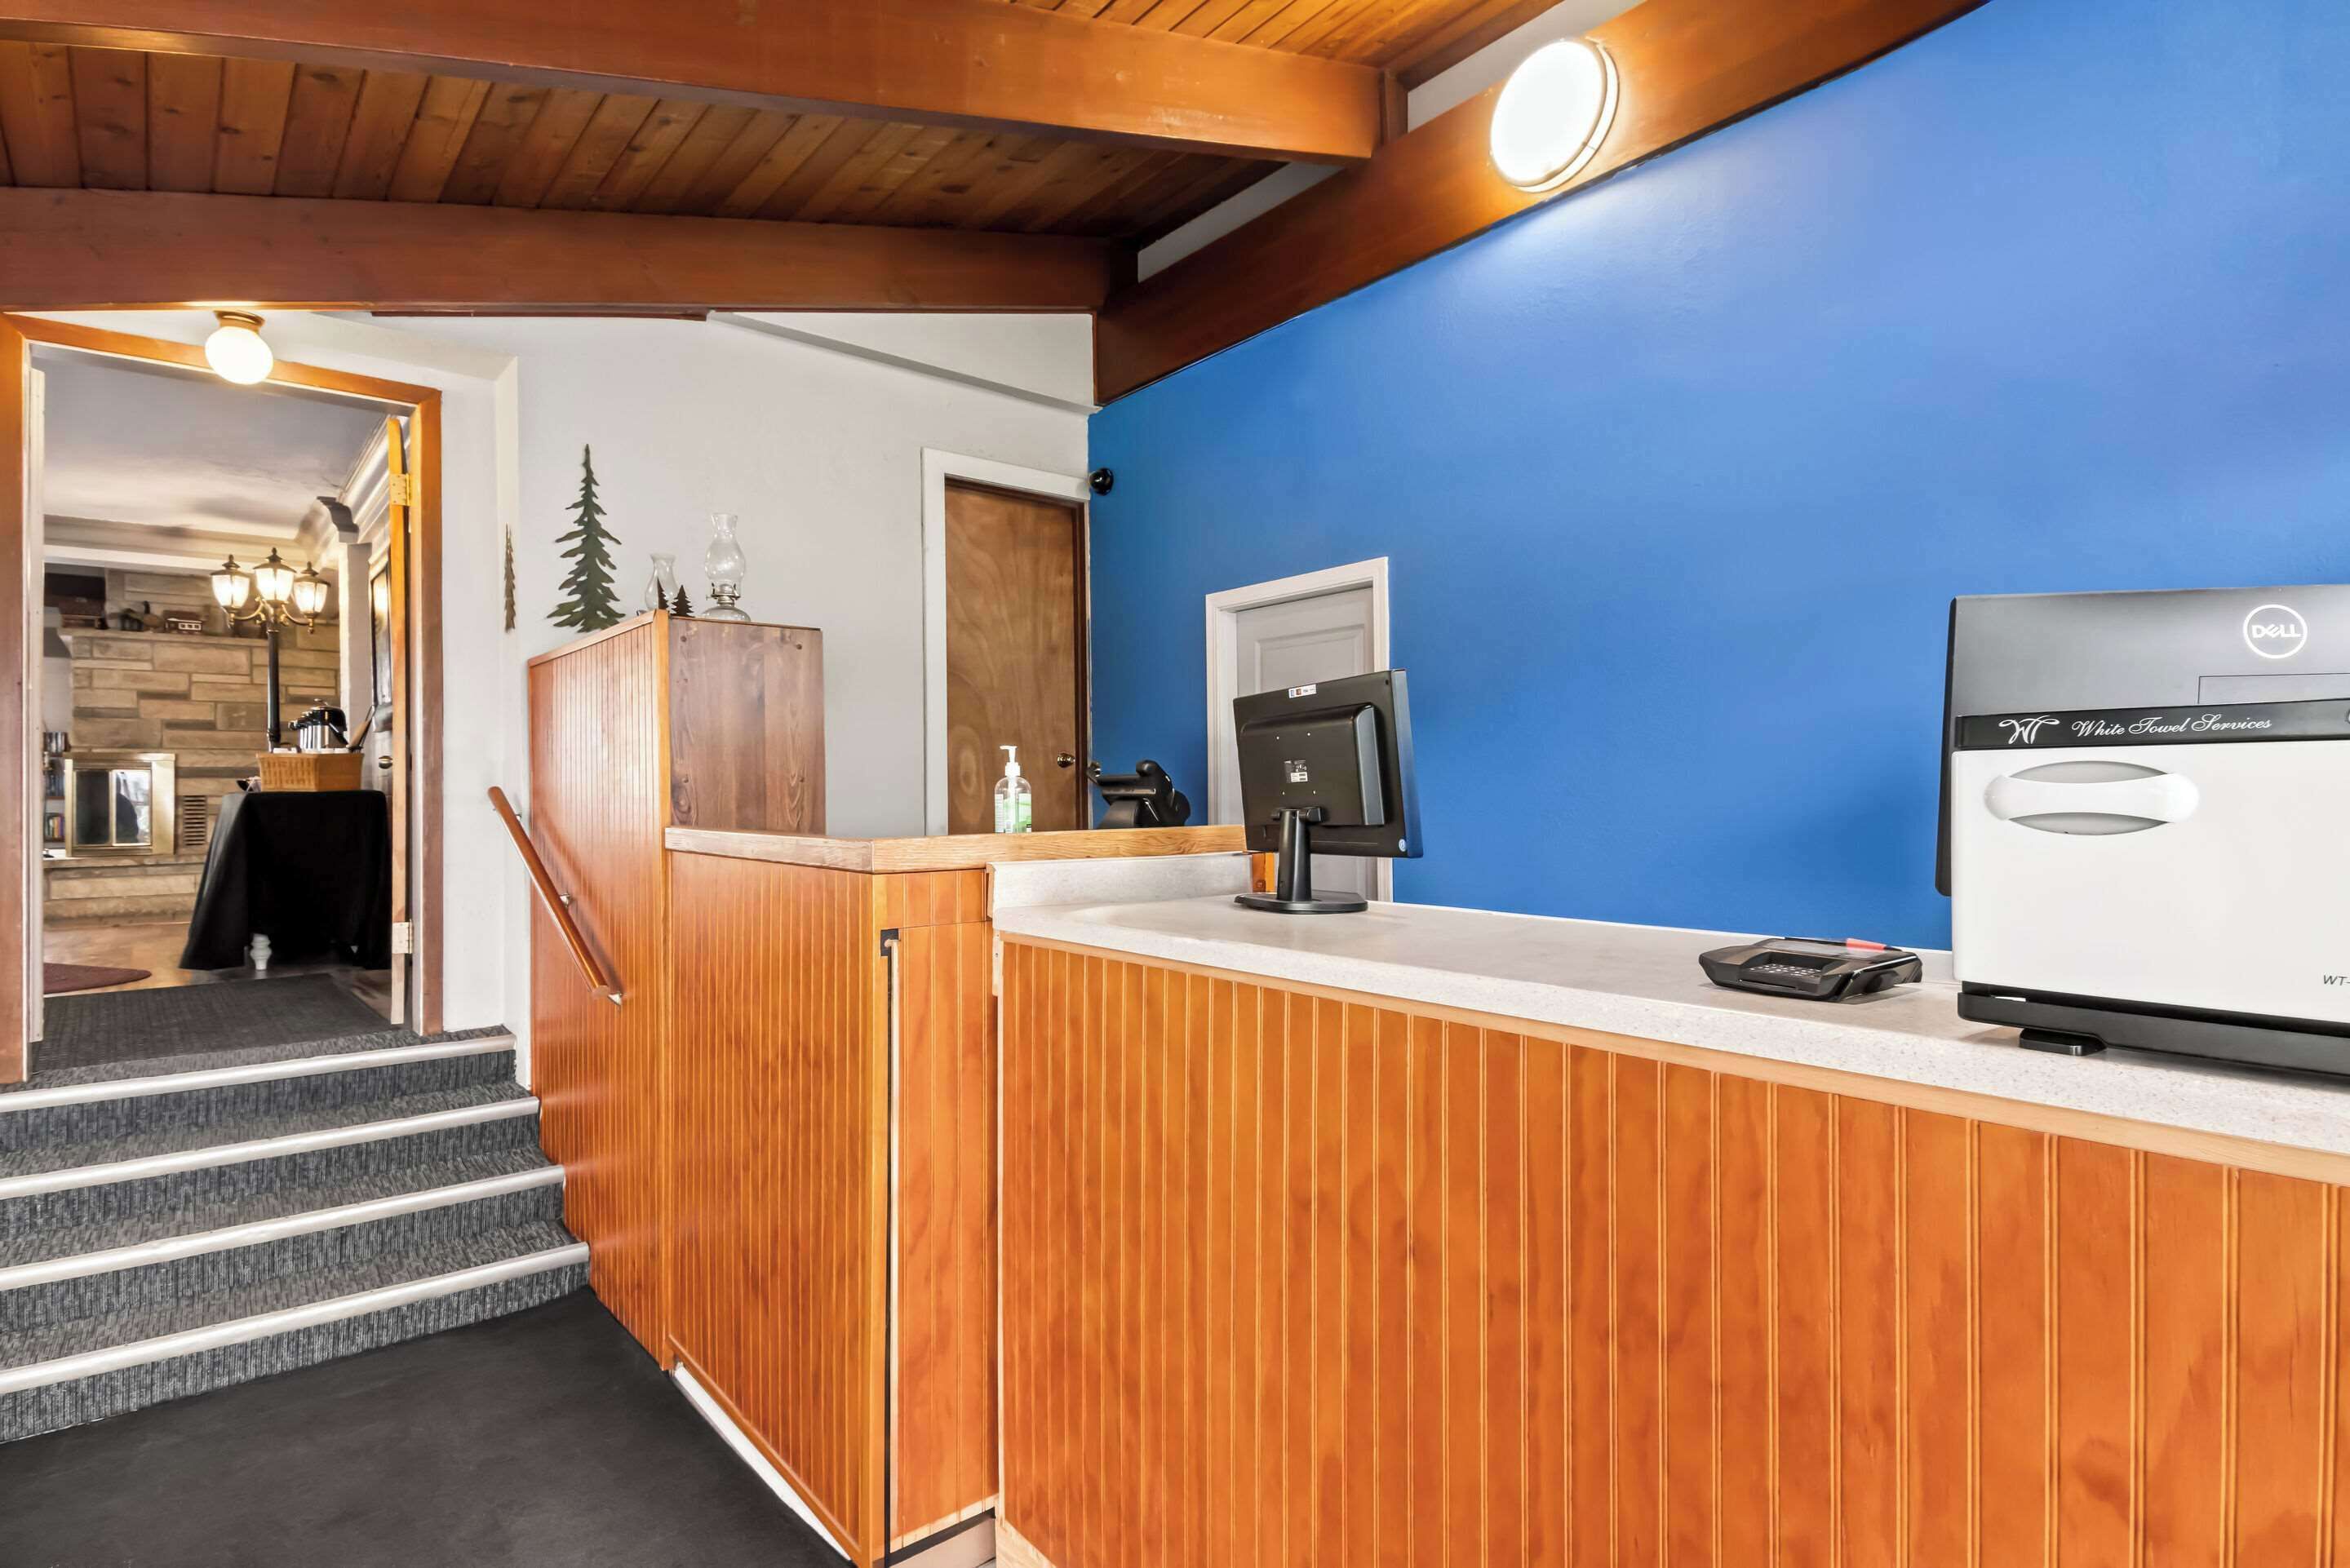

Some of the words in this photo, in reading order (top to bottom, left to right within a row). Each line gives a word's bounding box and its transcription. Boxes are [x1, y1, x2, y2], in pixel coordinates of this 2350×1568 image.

[2251, 623, 2302, 638] DELL
[2071, 720, 2126, 737] White
[2128, 716, 2193, 734] Towel
[2190, 713, 2272, 732] Services
